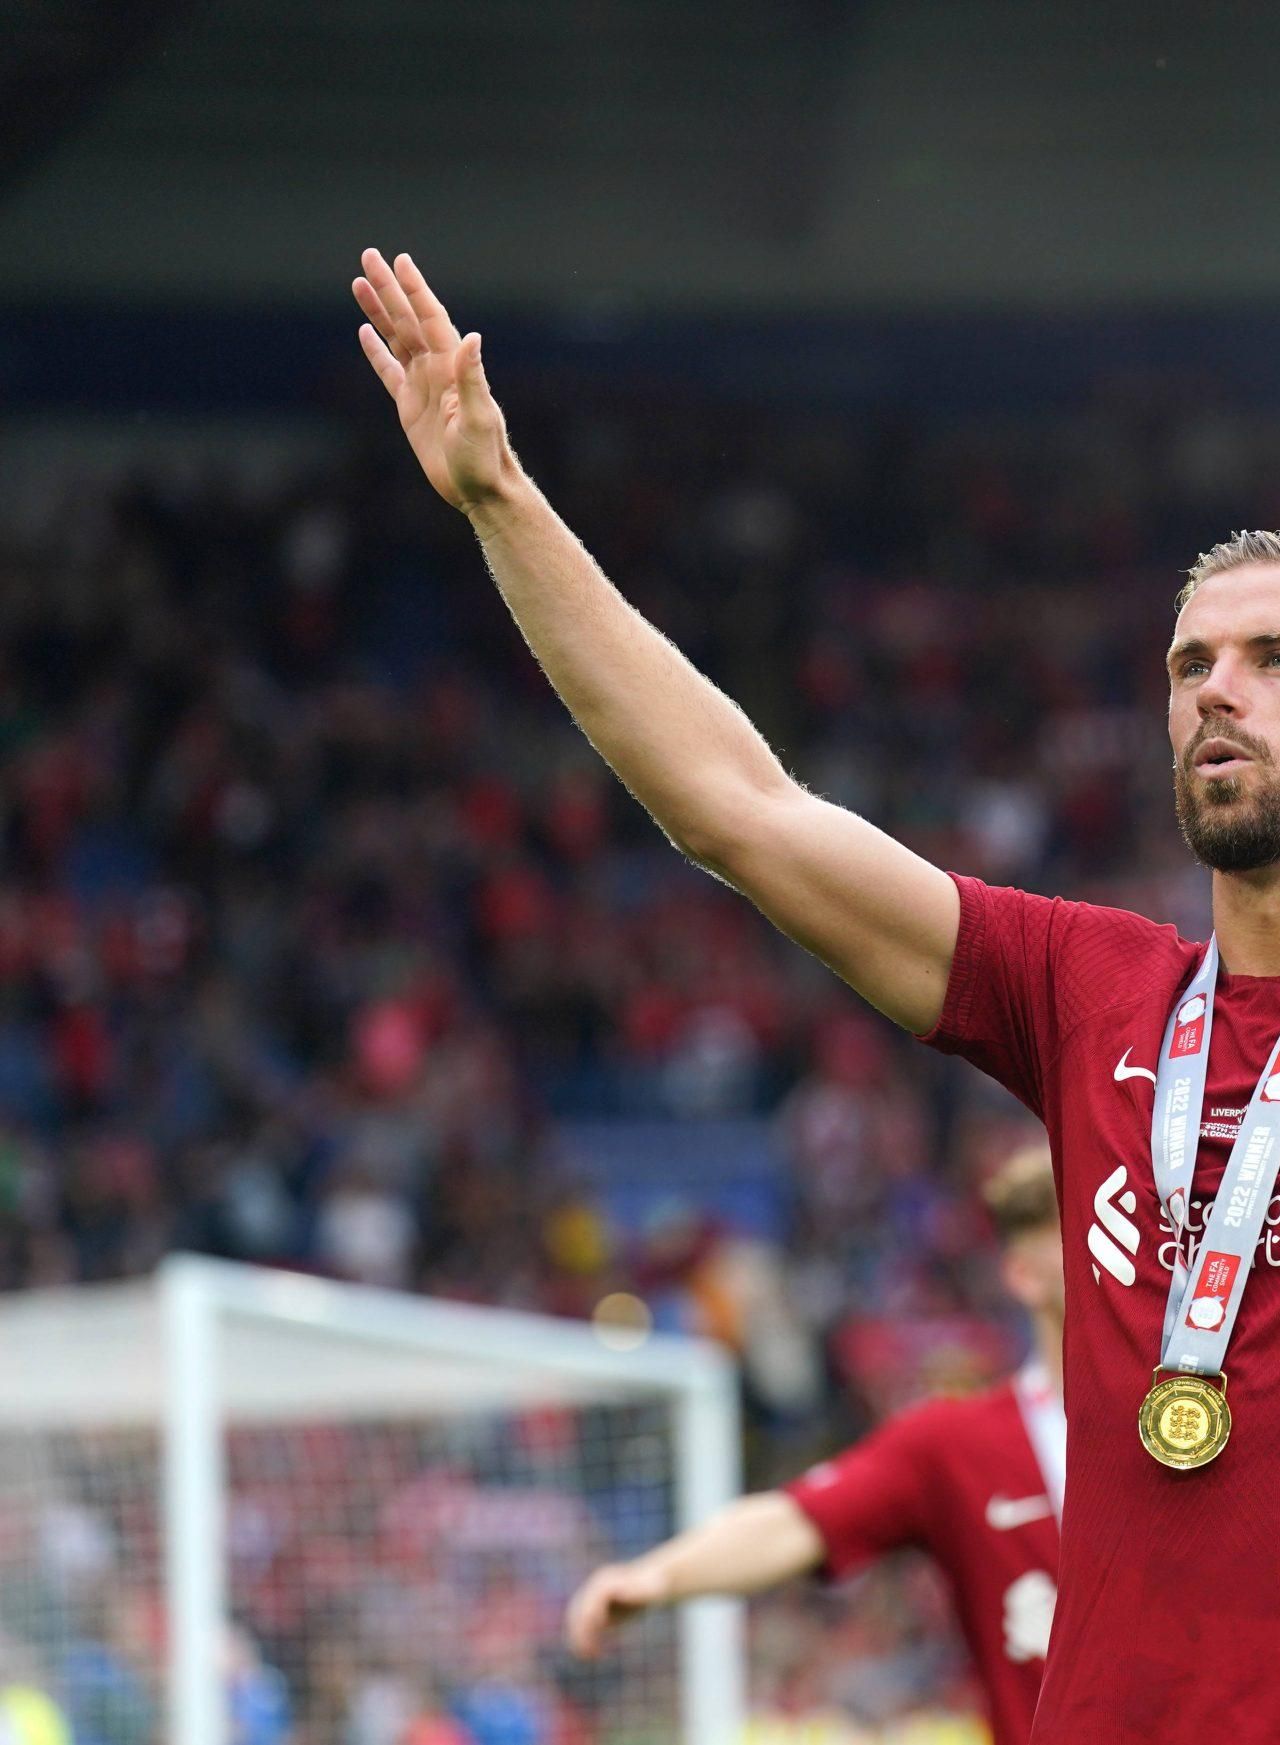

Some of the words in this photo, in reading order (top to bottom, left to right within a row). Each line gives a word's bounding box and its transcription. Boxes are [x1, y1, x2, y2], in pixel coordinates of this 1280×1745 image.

[1171, 1077, 1191, 1113] 2022
[1224, 1186, 1252, 1228] 2022
[1238, 1126, 1271, 1181] WINNER
[1205, 1273, 1216, 1288] THE
[1209, 1261, 1220, 1273] FA
[1211, 1258, 1227, 1293] COMMUNITY
[1219, 1266, 1230, 1287] SHIELD
